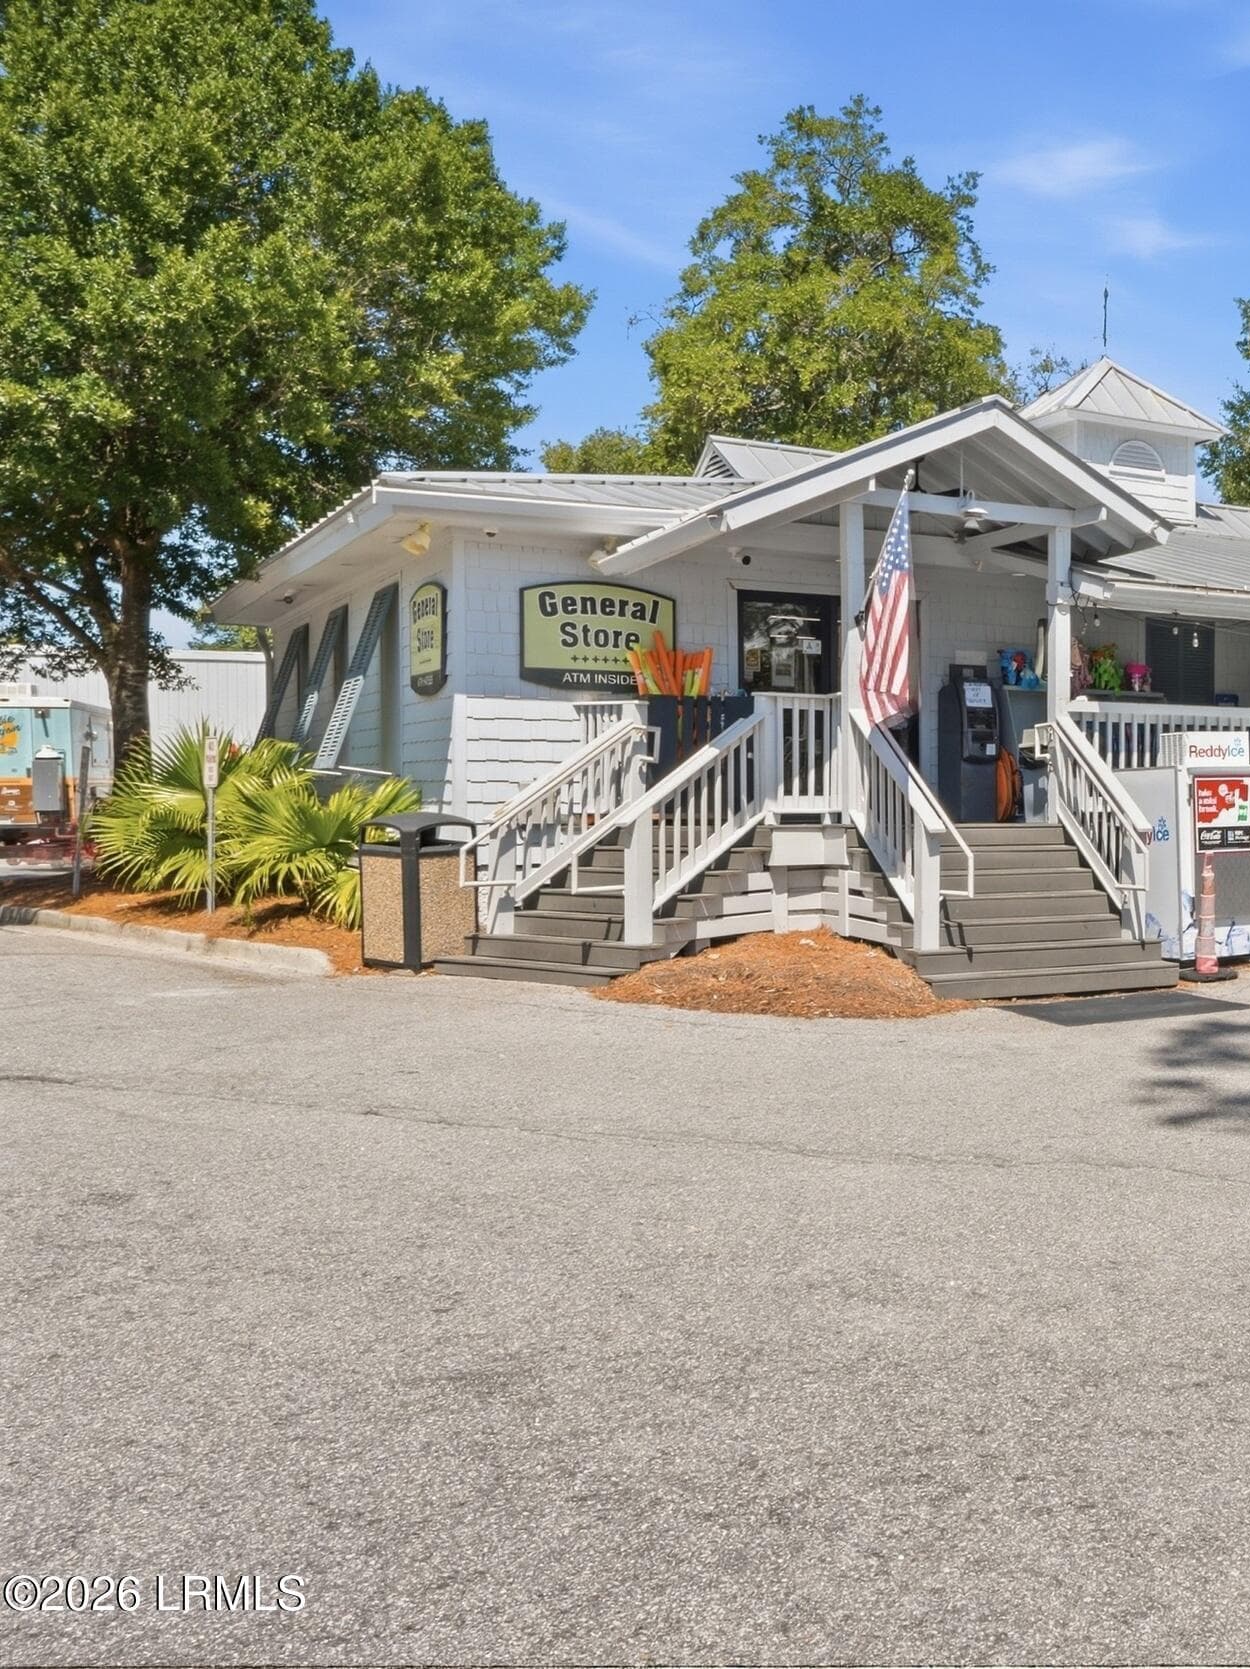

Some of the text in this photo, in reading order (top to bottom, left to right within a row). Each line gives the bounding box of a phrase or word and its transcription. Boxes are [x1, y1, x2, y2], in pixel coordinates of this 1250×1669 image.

[538, 591, 660, 625] General
[560, 621, 640, 651] Store
[562, 672, 638, 685] ATM INSIDE
